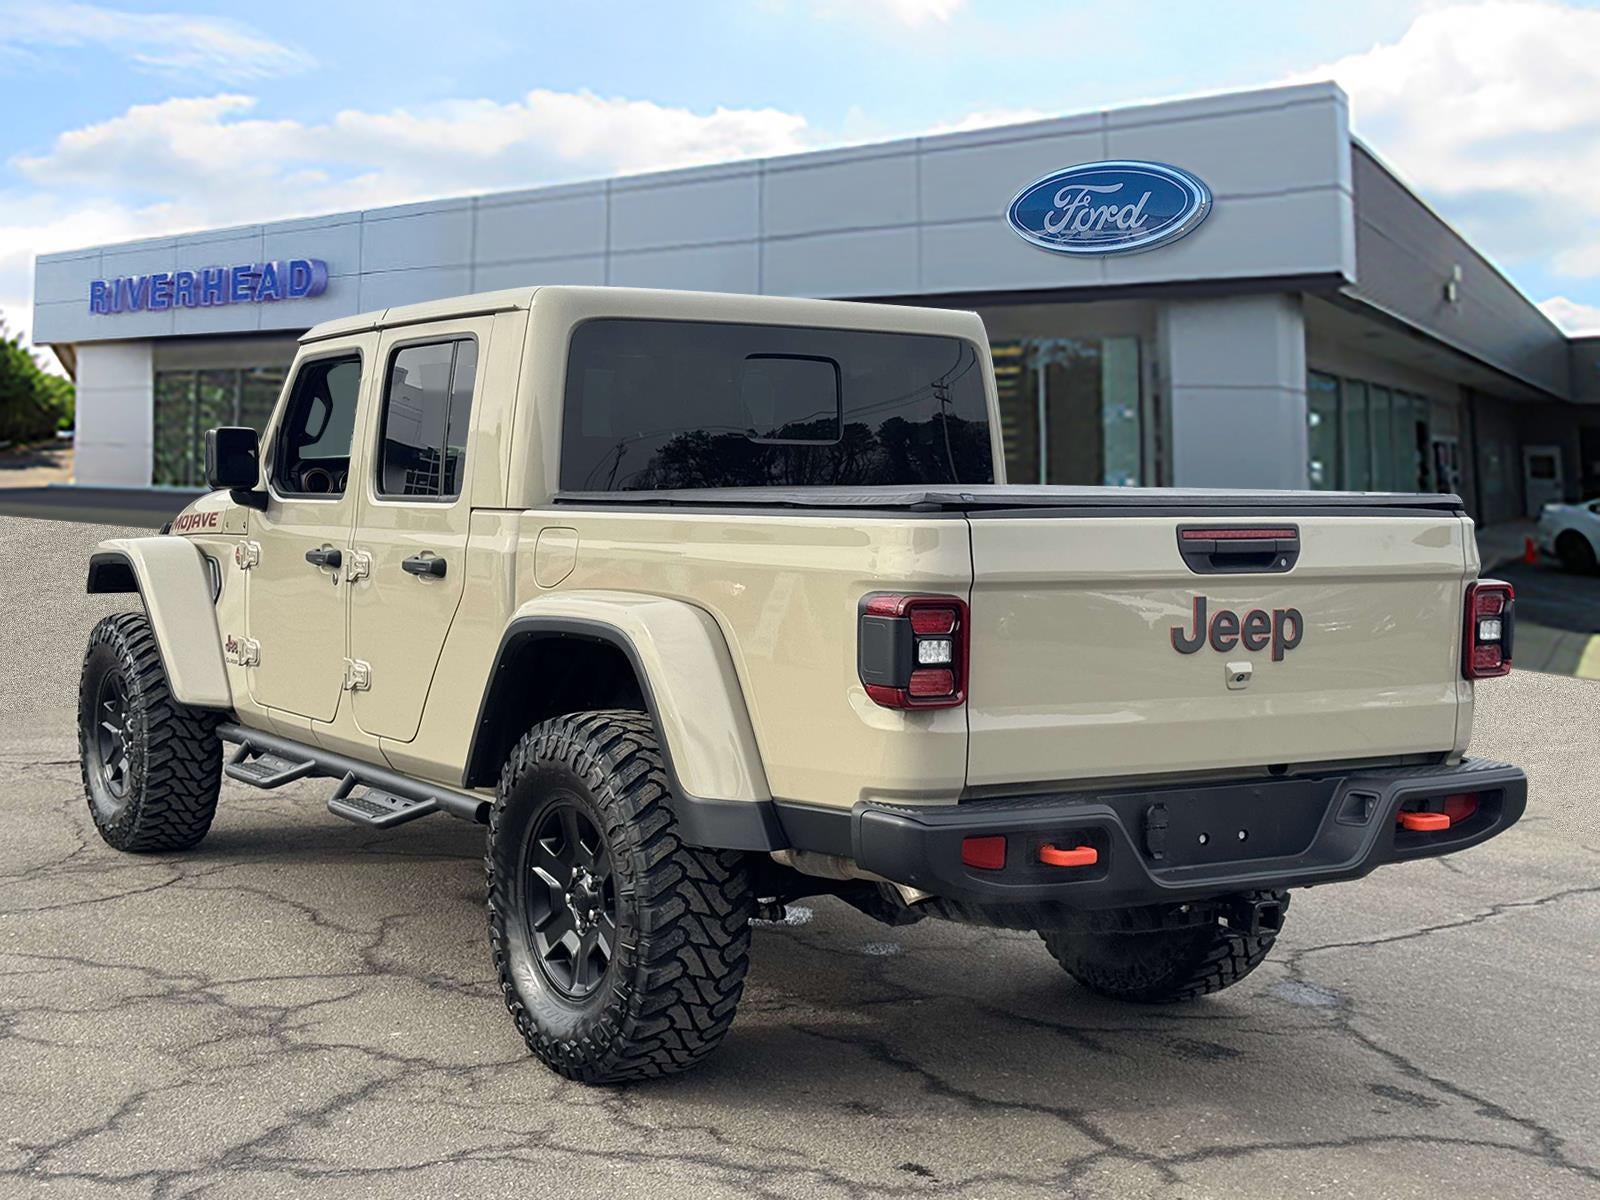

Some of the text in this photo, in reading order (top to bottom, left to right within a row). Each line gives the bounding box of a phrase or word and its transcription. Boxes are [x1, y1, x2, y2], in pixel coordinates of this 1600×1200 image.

[1043, 182, 1152, 233] Ford
[89, 258, 327, 315] RIVERHEAD
[1170, 595, 1304, 662] Jeep
